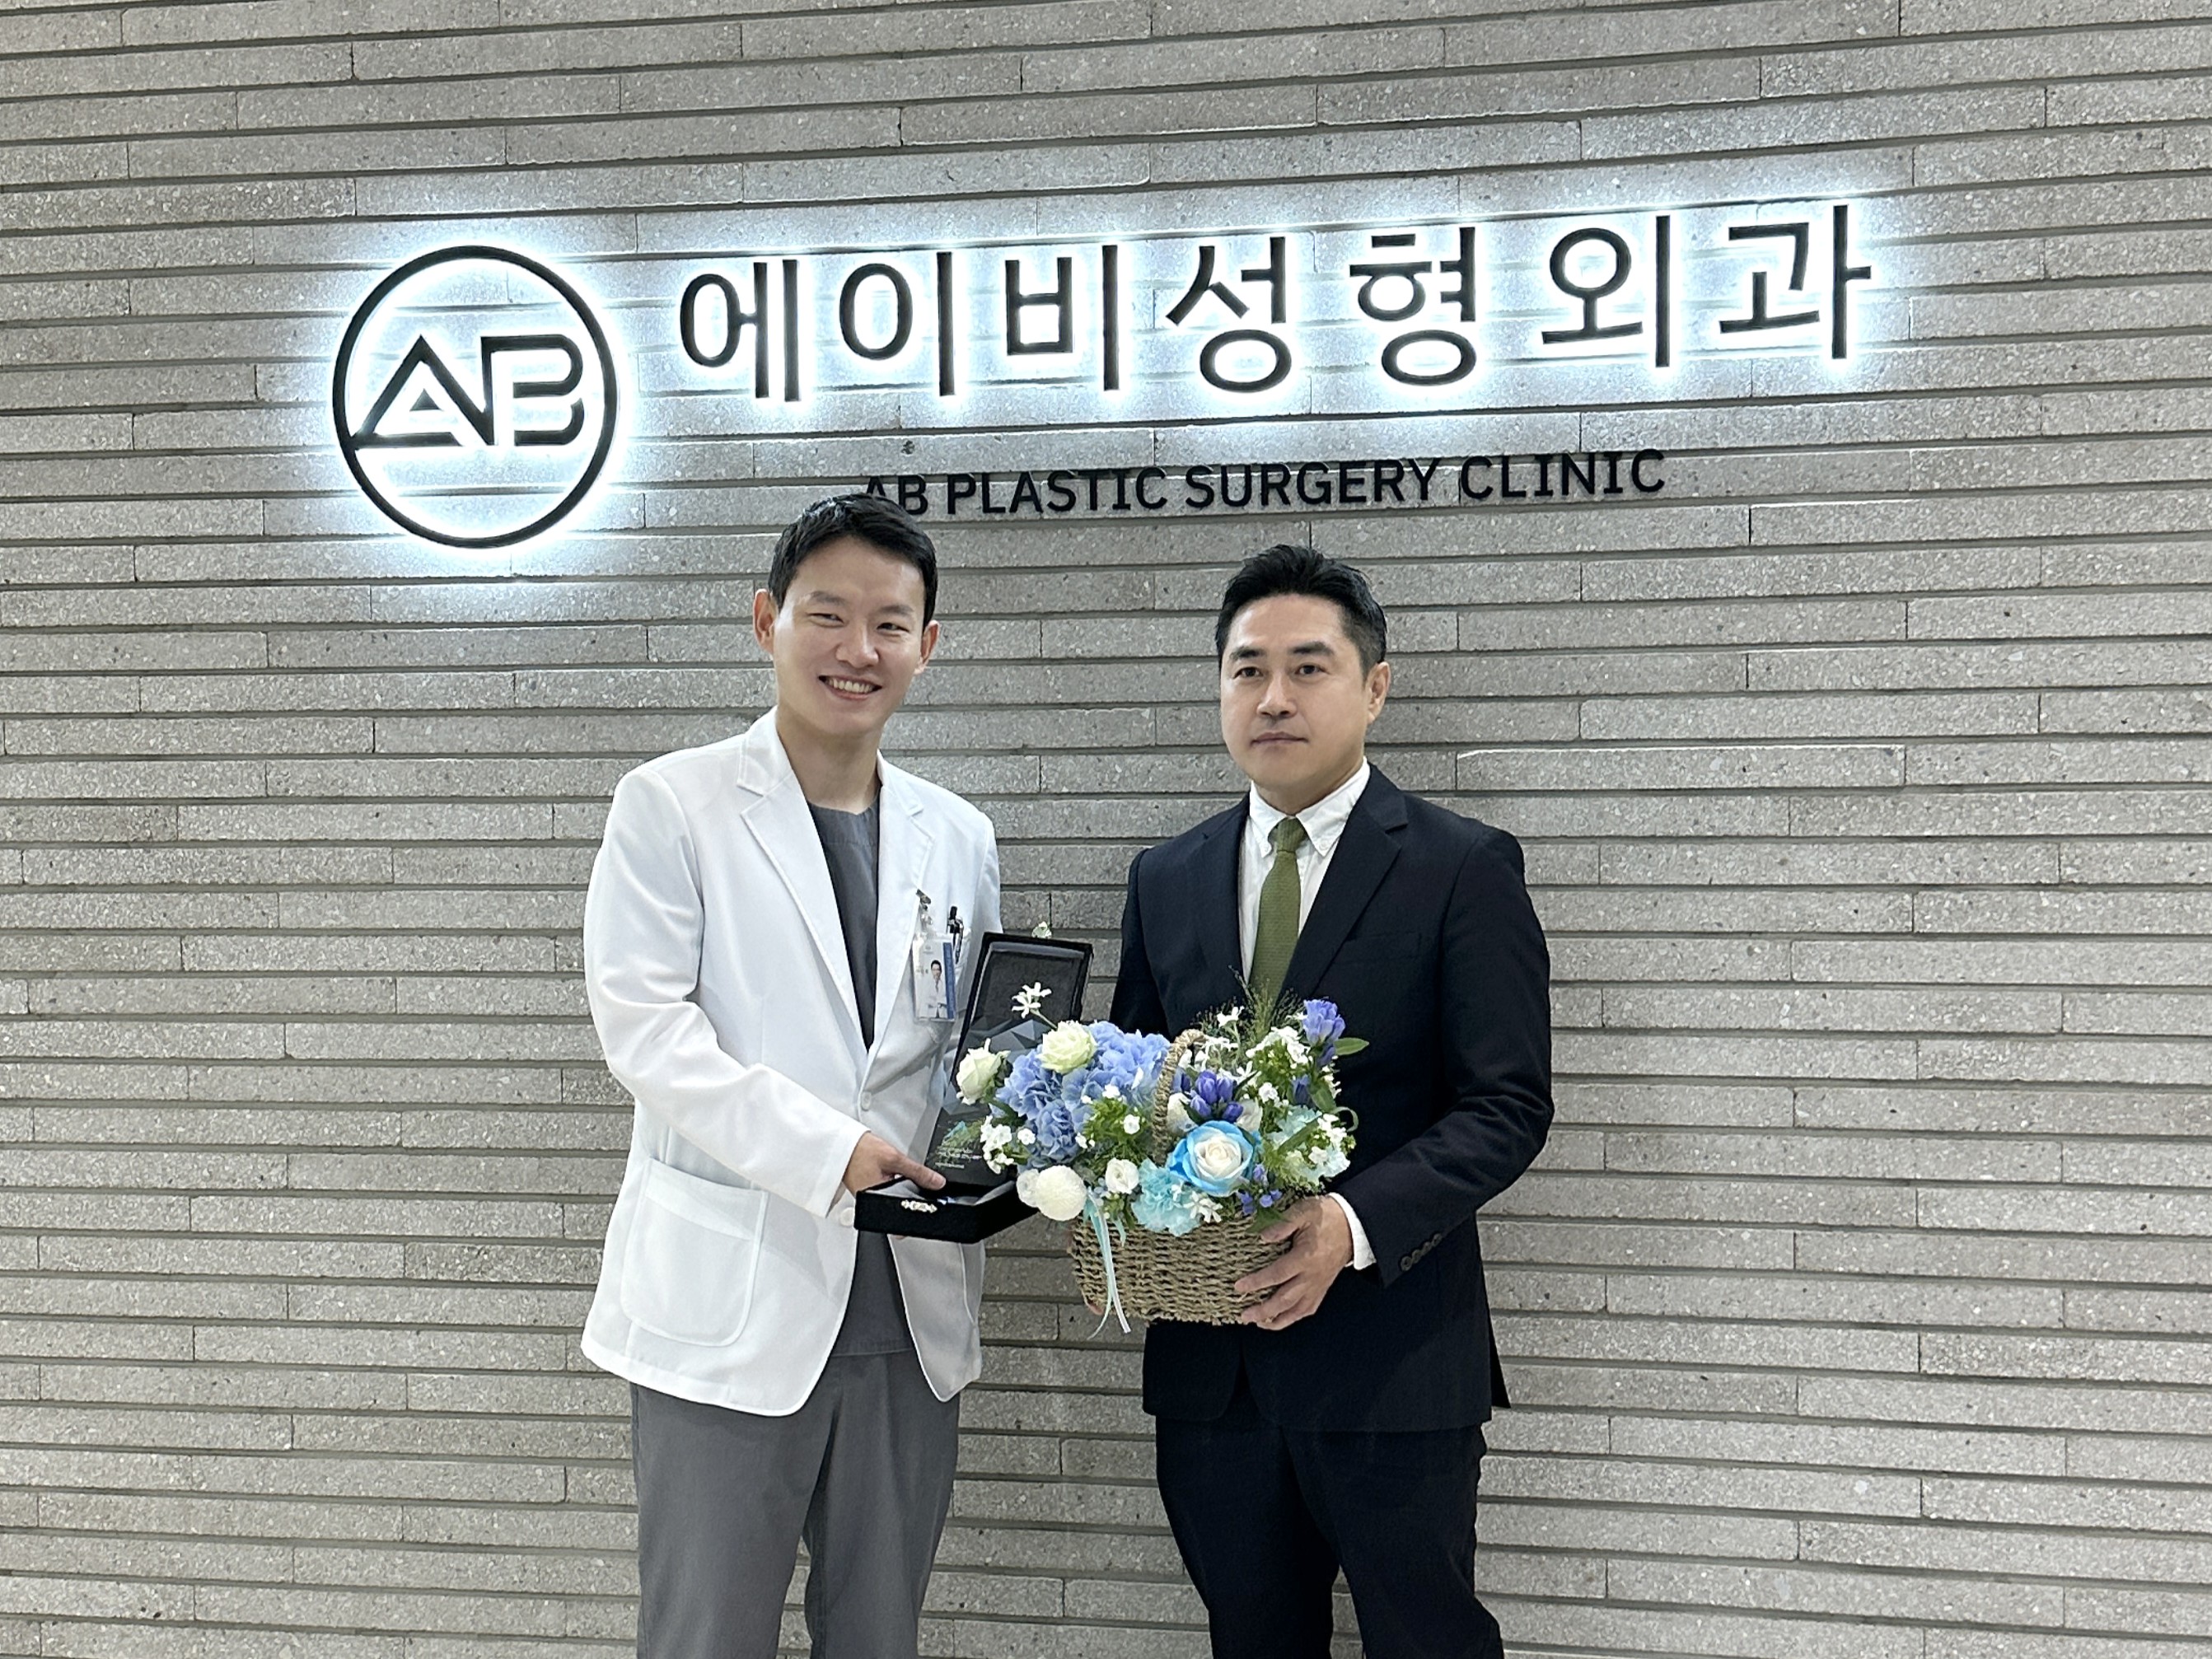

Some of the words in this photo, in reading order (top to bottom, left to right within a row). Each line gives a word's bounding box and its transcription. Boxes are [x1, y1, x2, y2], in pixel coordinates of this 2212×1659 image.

[680, 204, 1871, 402] 에이비성형외과
[353, 334, 585, 447] AB
[947, 467, 1167, 515] PLASTIC
[1186, 457, 1441, 508] SURGERY
[1461, 449, 1665, 499] CLINIC
